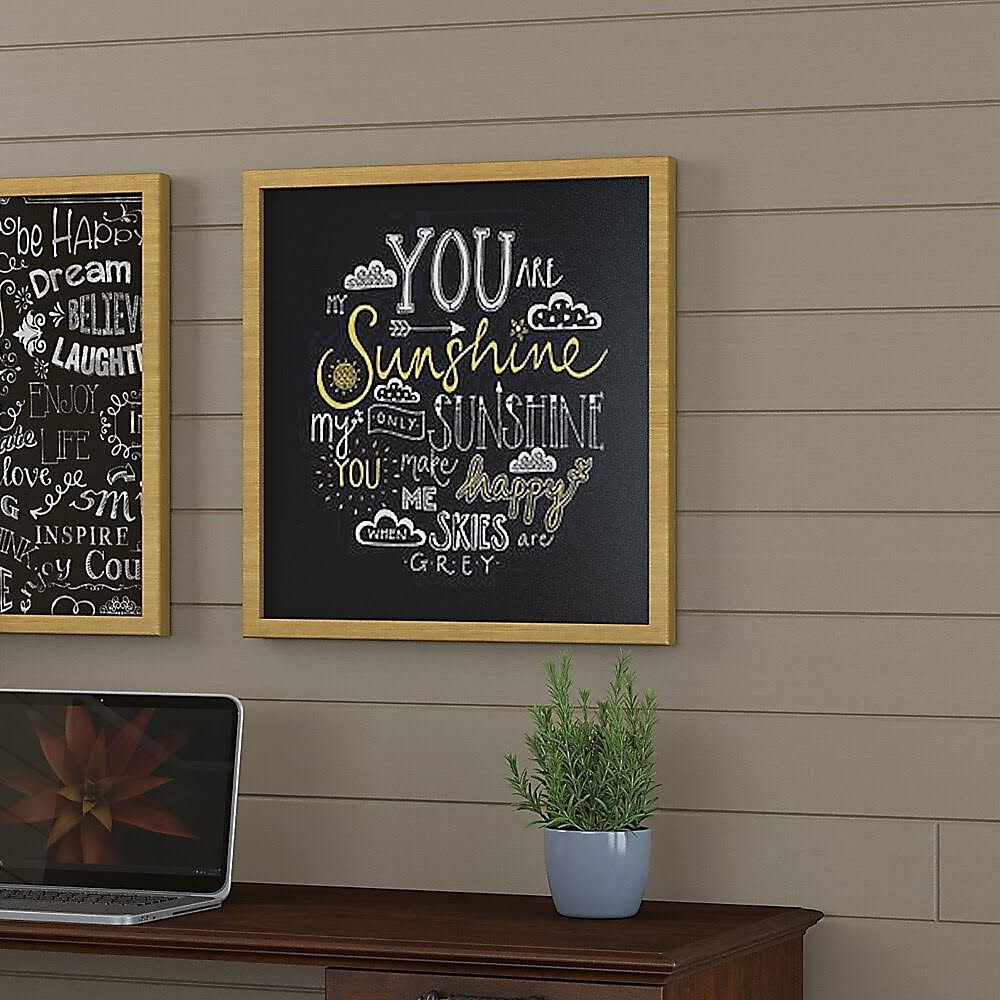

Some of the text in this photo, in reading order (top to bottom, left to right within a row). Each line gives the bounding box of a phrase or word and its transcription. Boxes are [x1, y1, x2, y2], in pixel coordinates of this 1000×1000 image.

[17, 216, 43, 257] be
[29, 259, 131, 299] Dream
[385, 227, 564, 313] YOU ARE
[68, 291, 142, 336] BELIEV
[326, 294, 348, 315] MY
[316, 304, 609, 409] Sunshine
[28, 382, 99, 418] ENJOY
[41, 428, 90, 464] LIFE
[311, 394, 605, 460] my ONLY SUNSHINE
[0, 456, 52, 487] love
[334, 449, 575, 533] YOU make ME happy
[35, 525, 129, 546] INSPIRE
[367, 510, 555, 551] WHEN SKIES are
